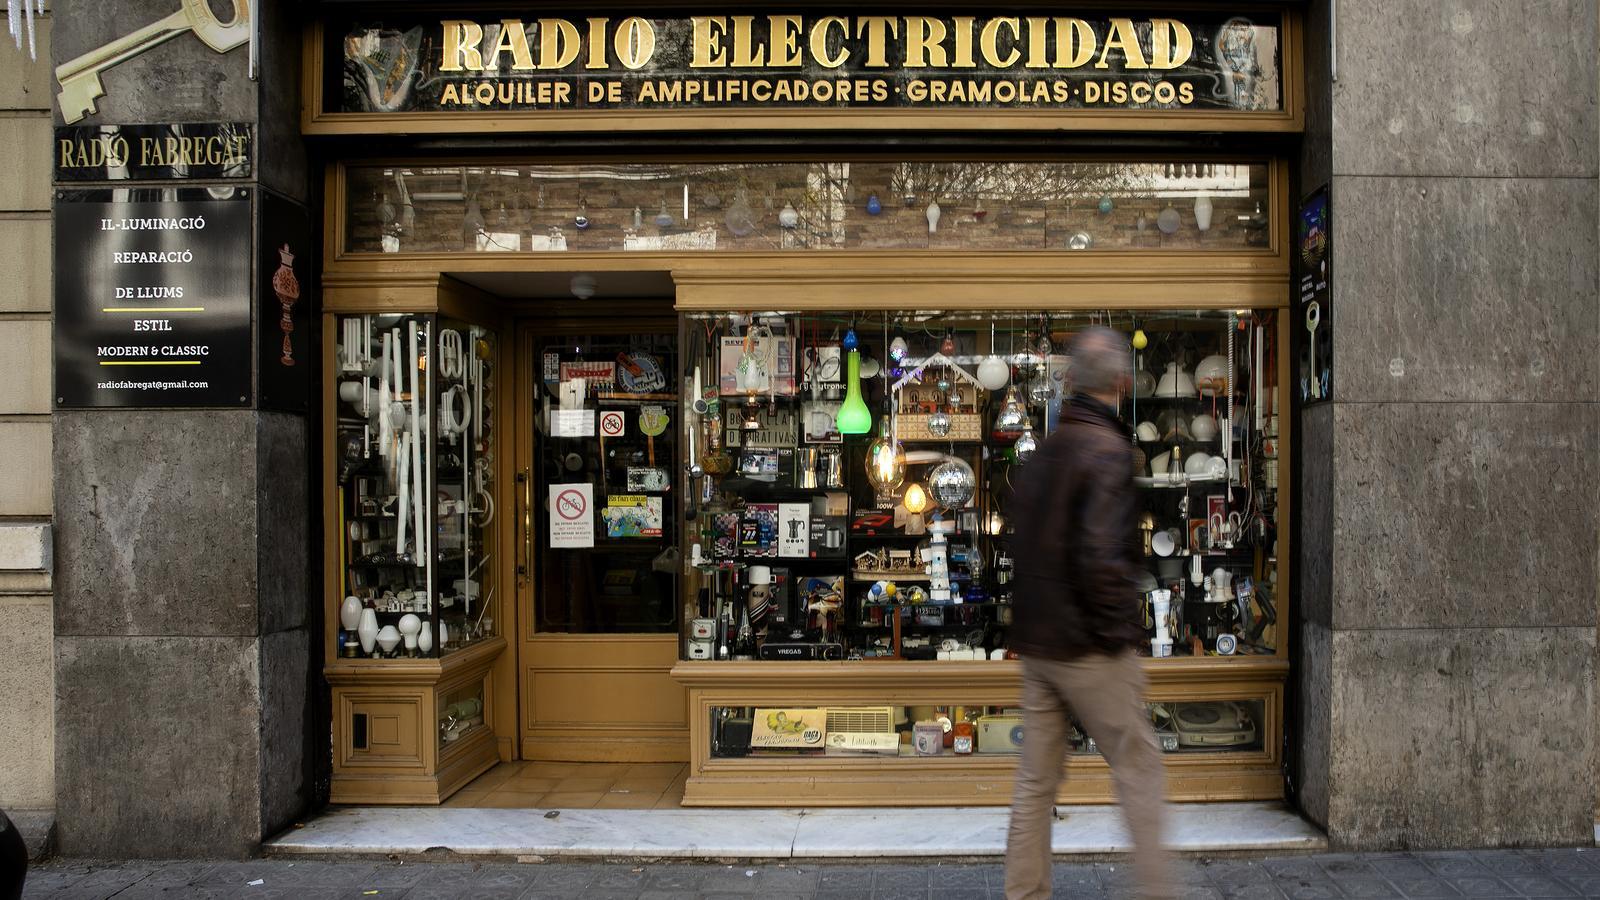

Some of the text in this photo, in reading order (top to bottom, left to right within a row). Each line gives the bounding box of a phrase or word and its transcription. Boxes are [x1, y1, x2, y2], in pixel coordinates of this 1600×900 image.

[439, 15, 1193, 71] RADIO ELECTRICIDAD
[440, 80, 1194, 105] ALQUILER DE AMPLIFICADORES GRAMOLAS DISCOS
[60, 136, 247, 168] RADIO FABREGAT
[113, 250, 193, 264] REPARACIÓ
[116, 287, 183, 299] DE LLUMS
[134, 320, 172, 332] ESTIL
[97, 345, 209, 357] MODERN & CLASSIC
[97, 379, 209, 391] radiofabregat@gmail.com
